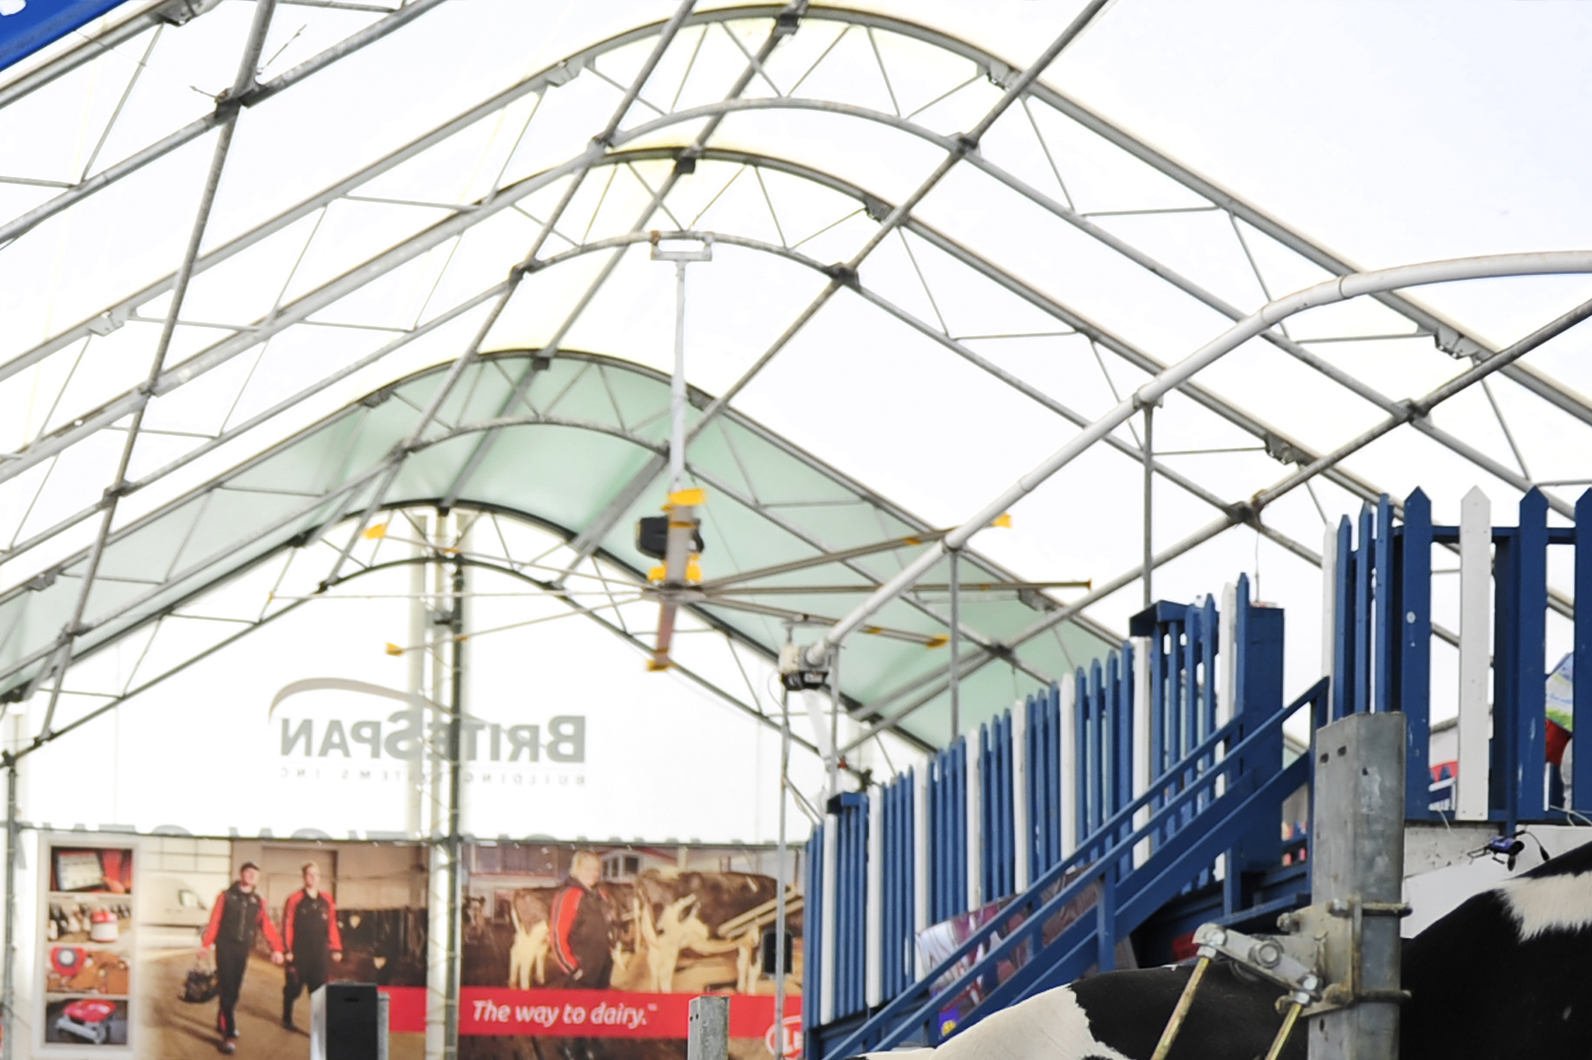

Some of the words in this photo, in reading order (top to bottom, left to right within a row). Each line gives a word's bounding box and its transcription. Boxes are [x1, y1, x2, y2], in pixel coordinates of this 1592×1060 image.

[472, 1000, 510, 1022] The
[515, 1004, 558, 1028] way
[563, 1003, 587, 1025] to
